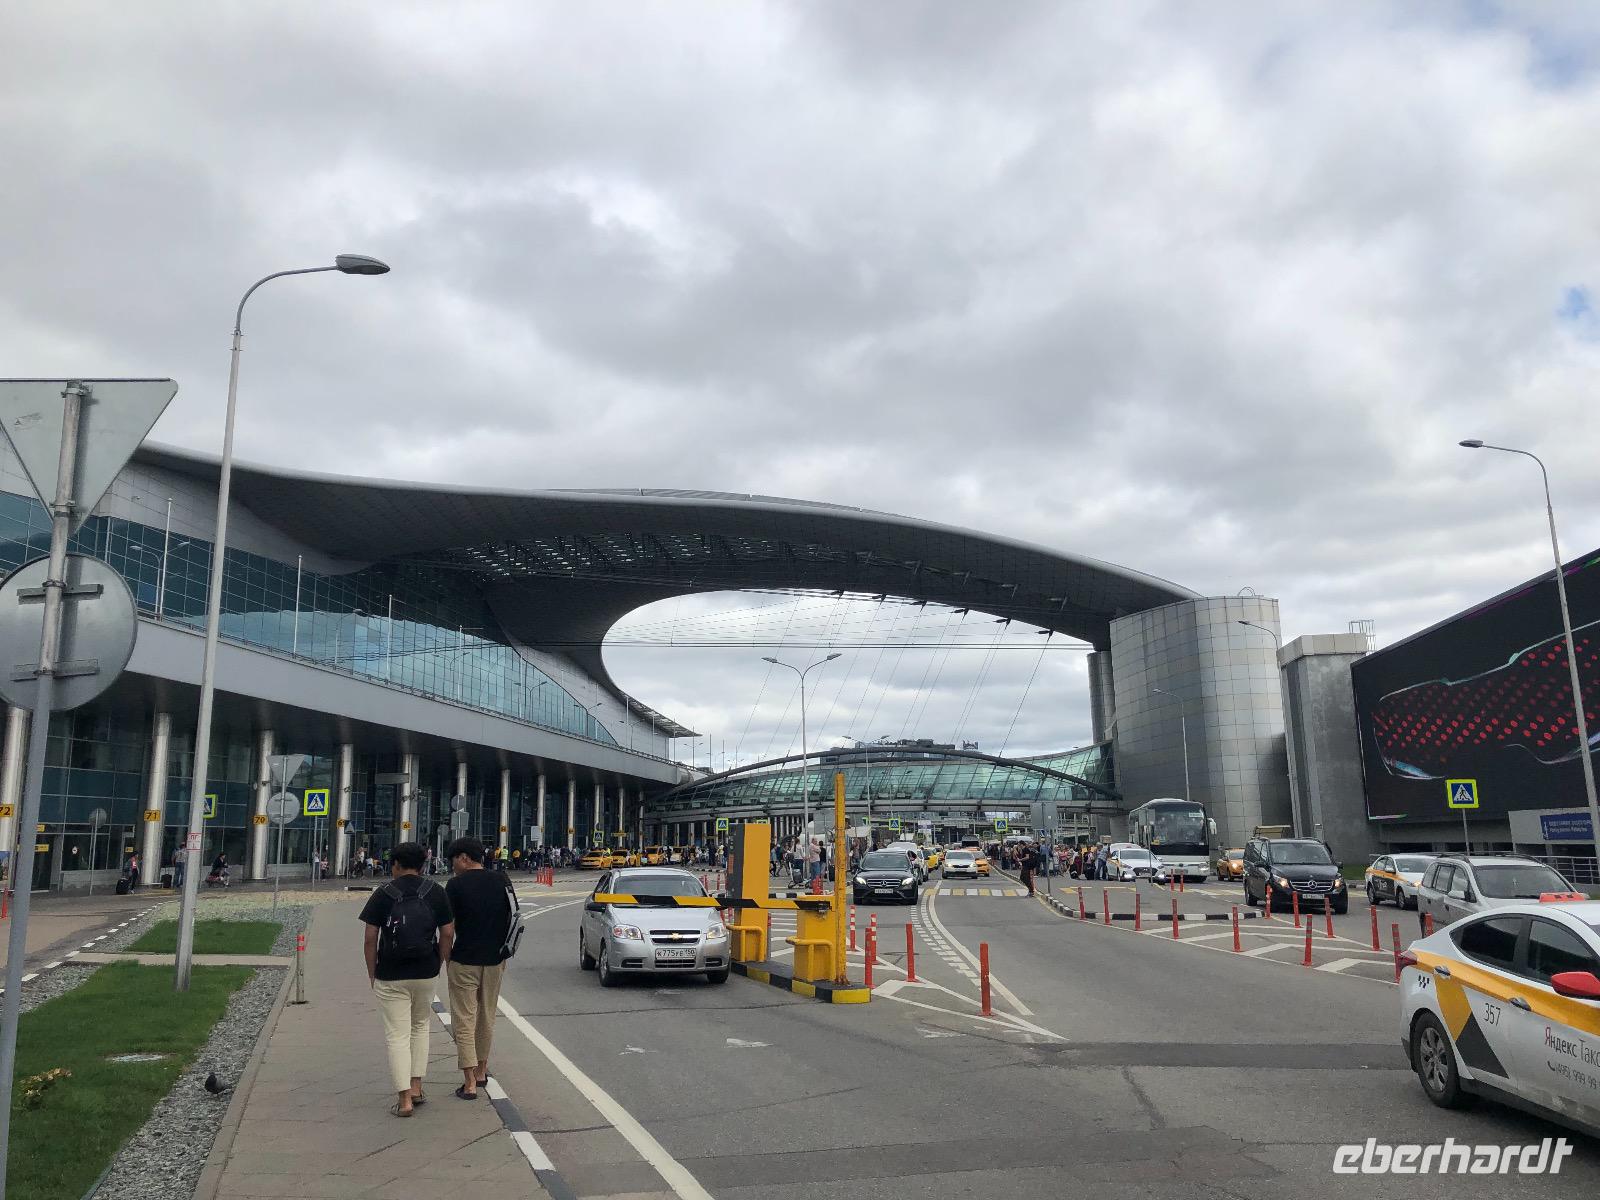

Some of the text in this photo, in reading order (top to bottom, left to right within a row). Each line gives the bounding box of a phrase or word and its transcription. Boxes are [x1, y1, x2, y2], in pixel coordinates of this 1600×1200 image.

[145, 812, 157, 820] 71
[255, 816, 266, 824] 70
[1483, 1002, 1501, 1026] 357
[1545, 1026, 1578, 1058] Яндекс
